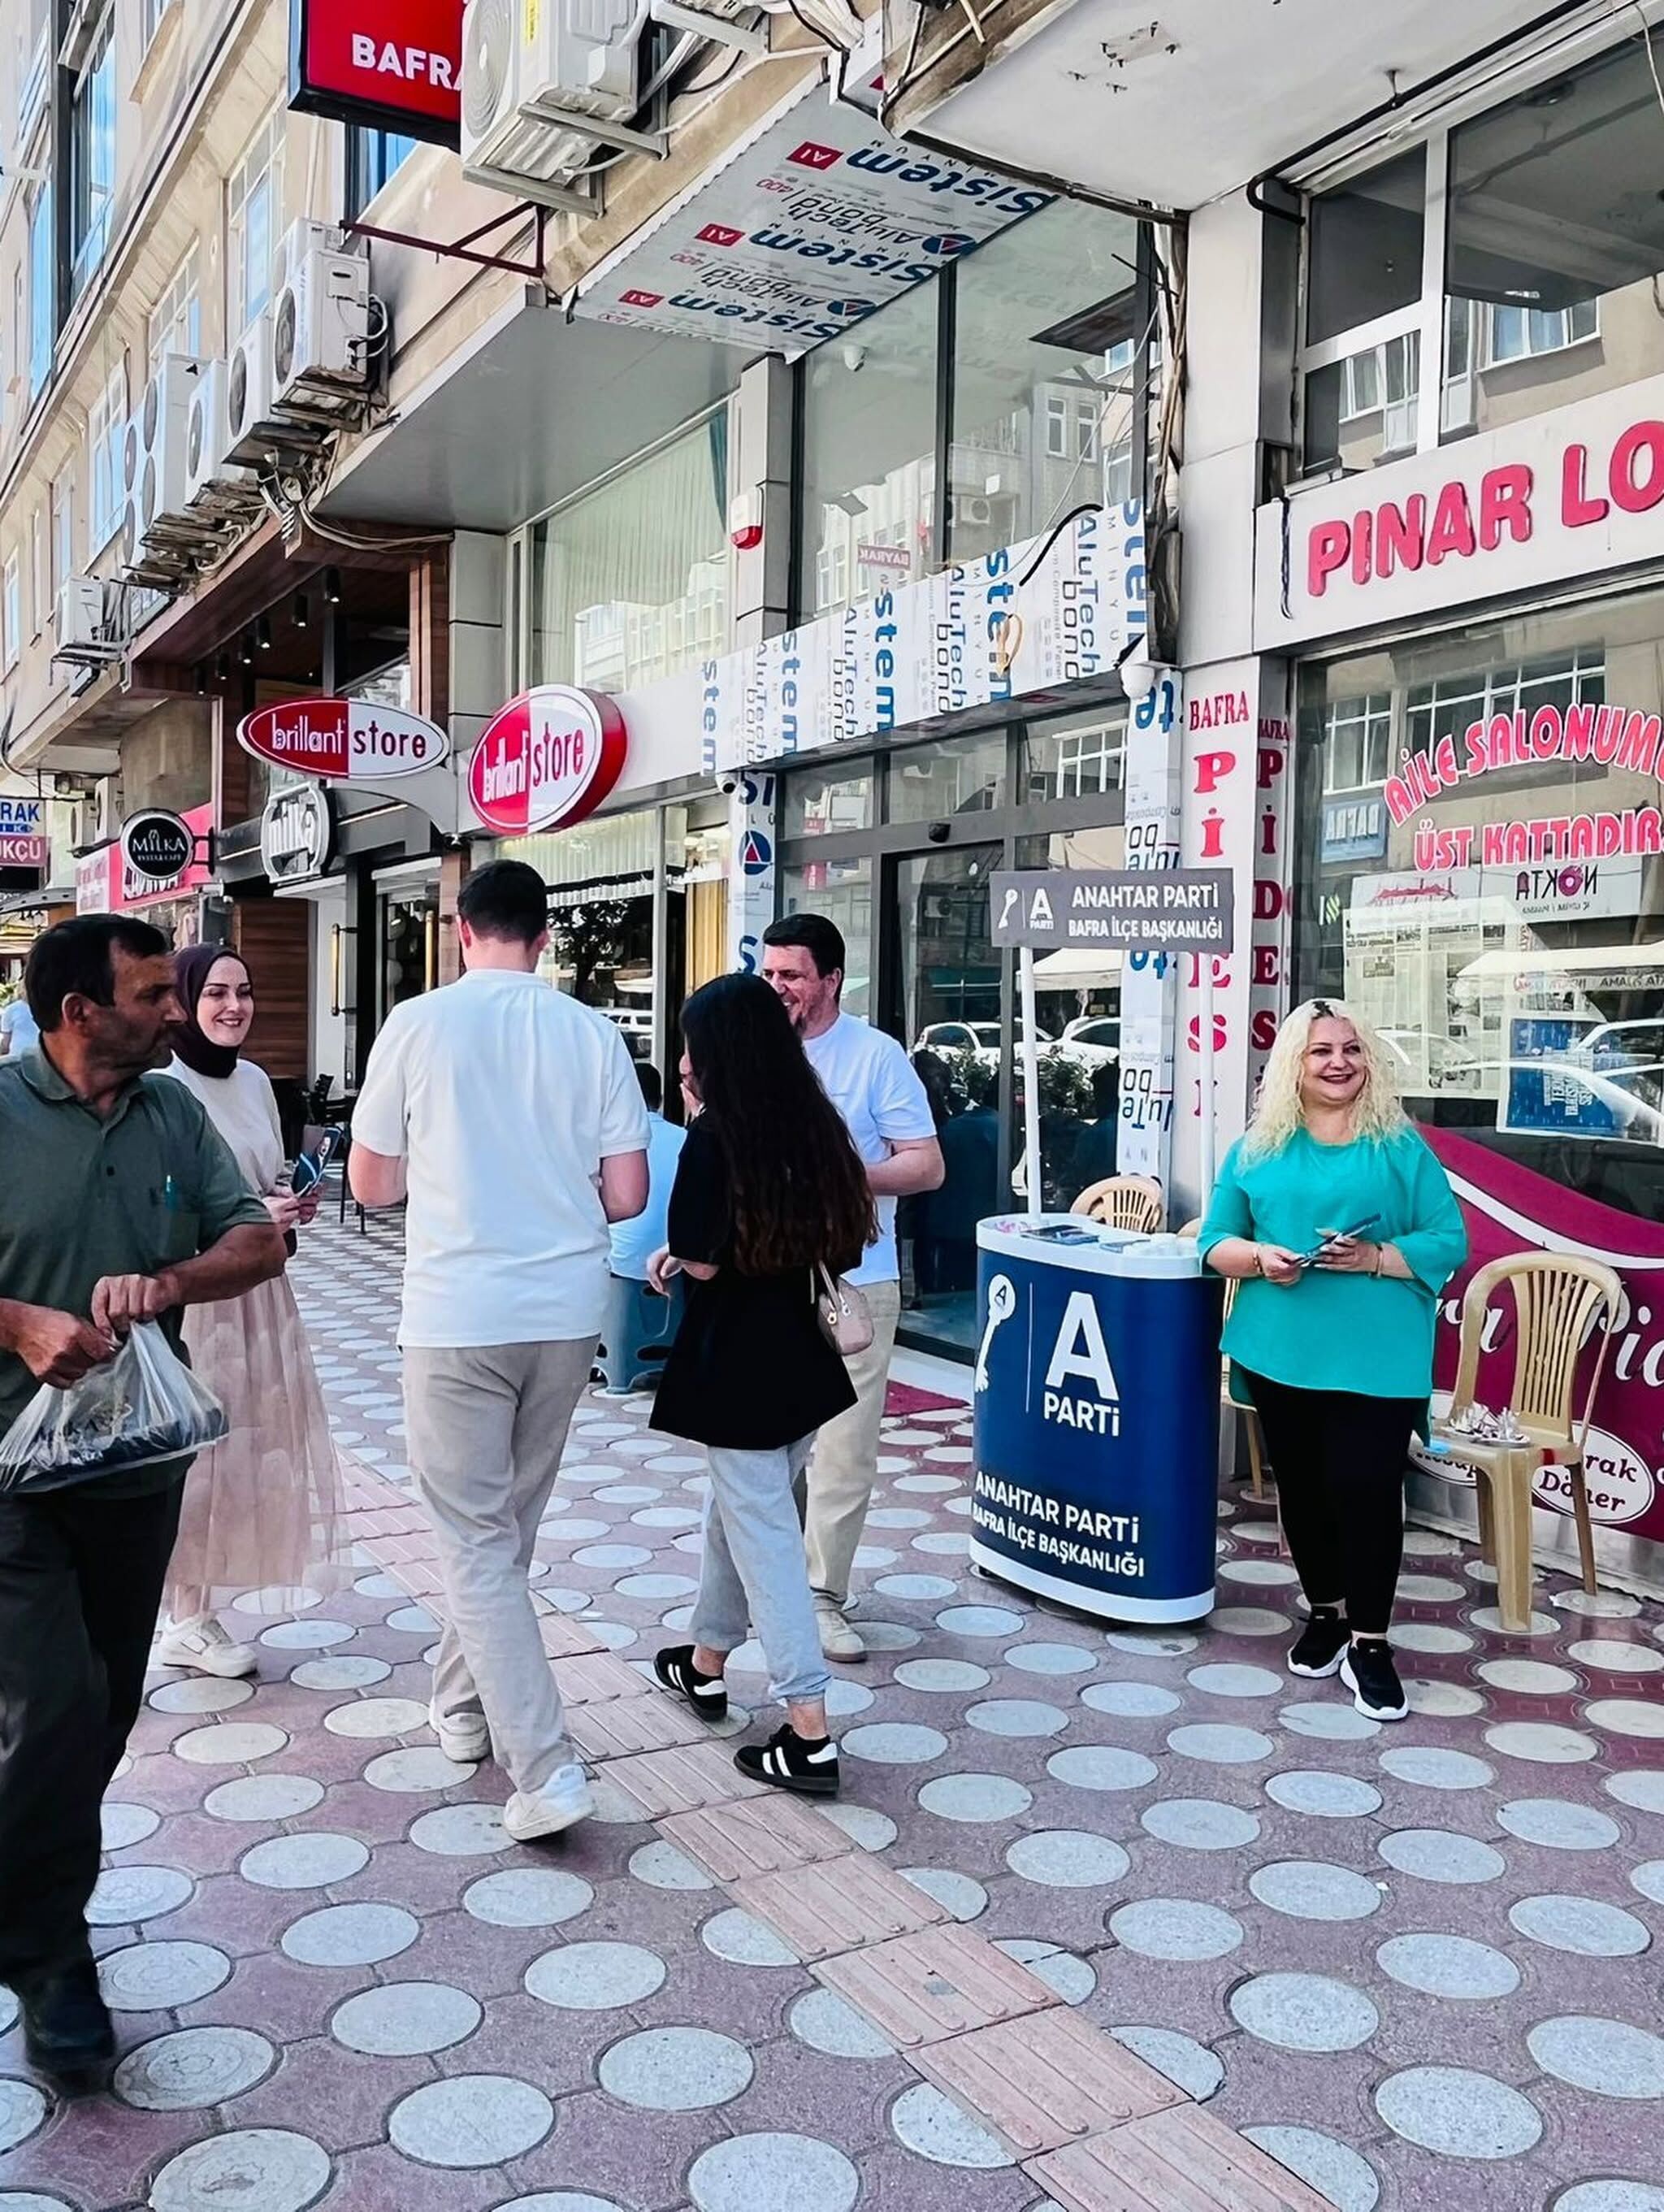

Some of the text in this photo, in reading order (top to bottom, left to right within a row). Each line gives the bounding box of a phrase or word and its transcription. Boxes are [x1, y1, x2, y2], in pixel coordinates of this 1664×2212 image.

[351, 33, 461, 91] BAFR
[846, 147, 1058, 213] Sistem
[749, 228, 940, 282] Sistem
[668, 292, 843, 340] Sistem
[1308, 419, 1664, 597] PINAR LO
[874, 591, 897, 731] stem
[272, 713, 427, 759] brillant store
[1190, 691, 1250, 731] BAFRA
[532, 721, 584, 787] store
[1415, 818, 1474, 872] ÜST
[1029, 887, 1054, 919] A
[1072, 885, 1159, 909] ANAHTAR
[1068, 915, 1223, 943] BAFRA İLÇE BAŞKANLIĞI
[1045, 1290, 1120, 1401] A
[975, 1470, 1060, 1525] ANAHTAR
[973, 1502, 1145, 1578] BAFRA İLÇE BAŞKANLIĞI
